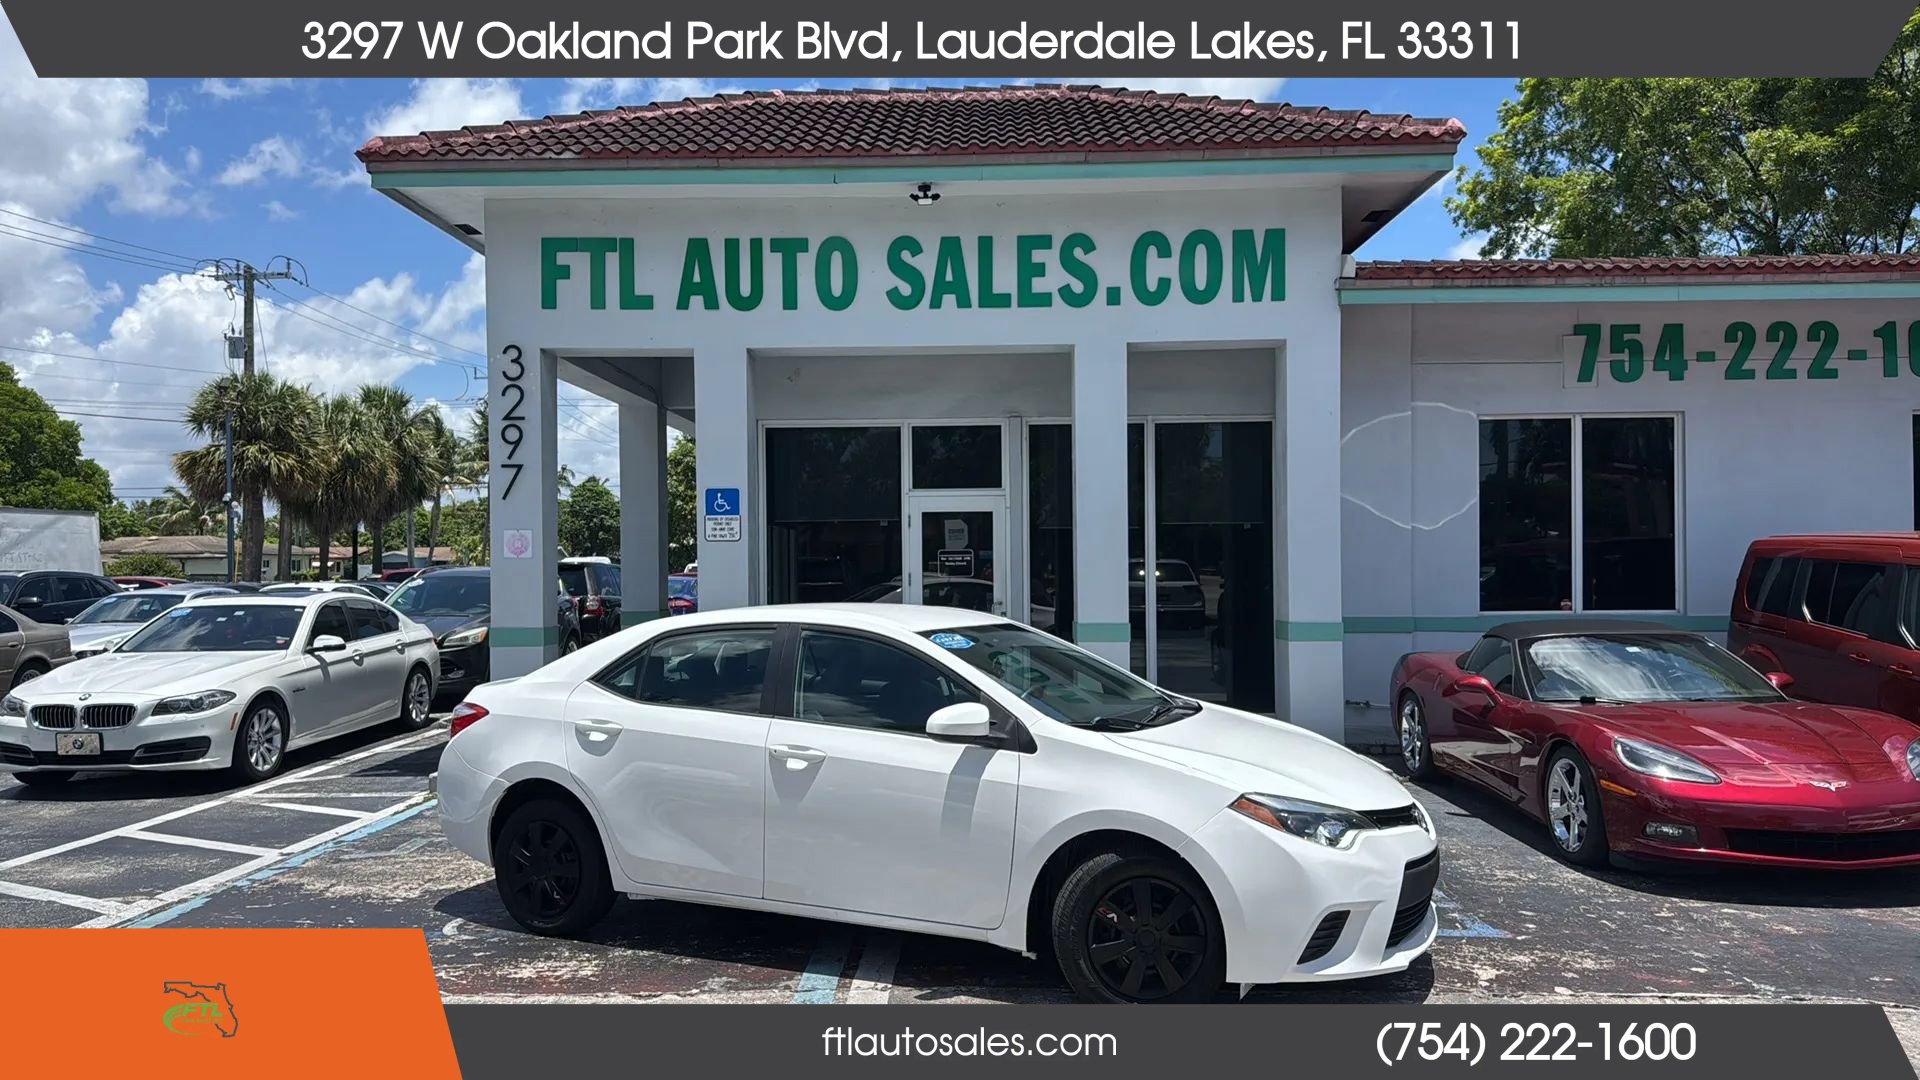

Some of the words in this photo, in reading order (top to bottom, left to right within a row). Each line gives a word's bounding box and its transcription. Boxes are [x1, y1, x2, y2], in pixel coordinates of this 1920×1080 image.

[540, 237, 655, 311] FTL
[676, 235, 860, 313] AUTO
[886, 228, 1289, 312] SALES.COM
[500, 344, 526, 501] 3297
